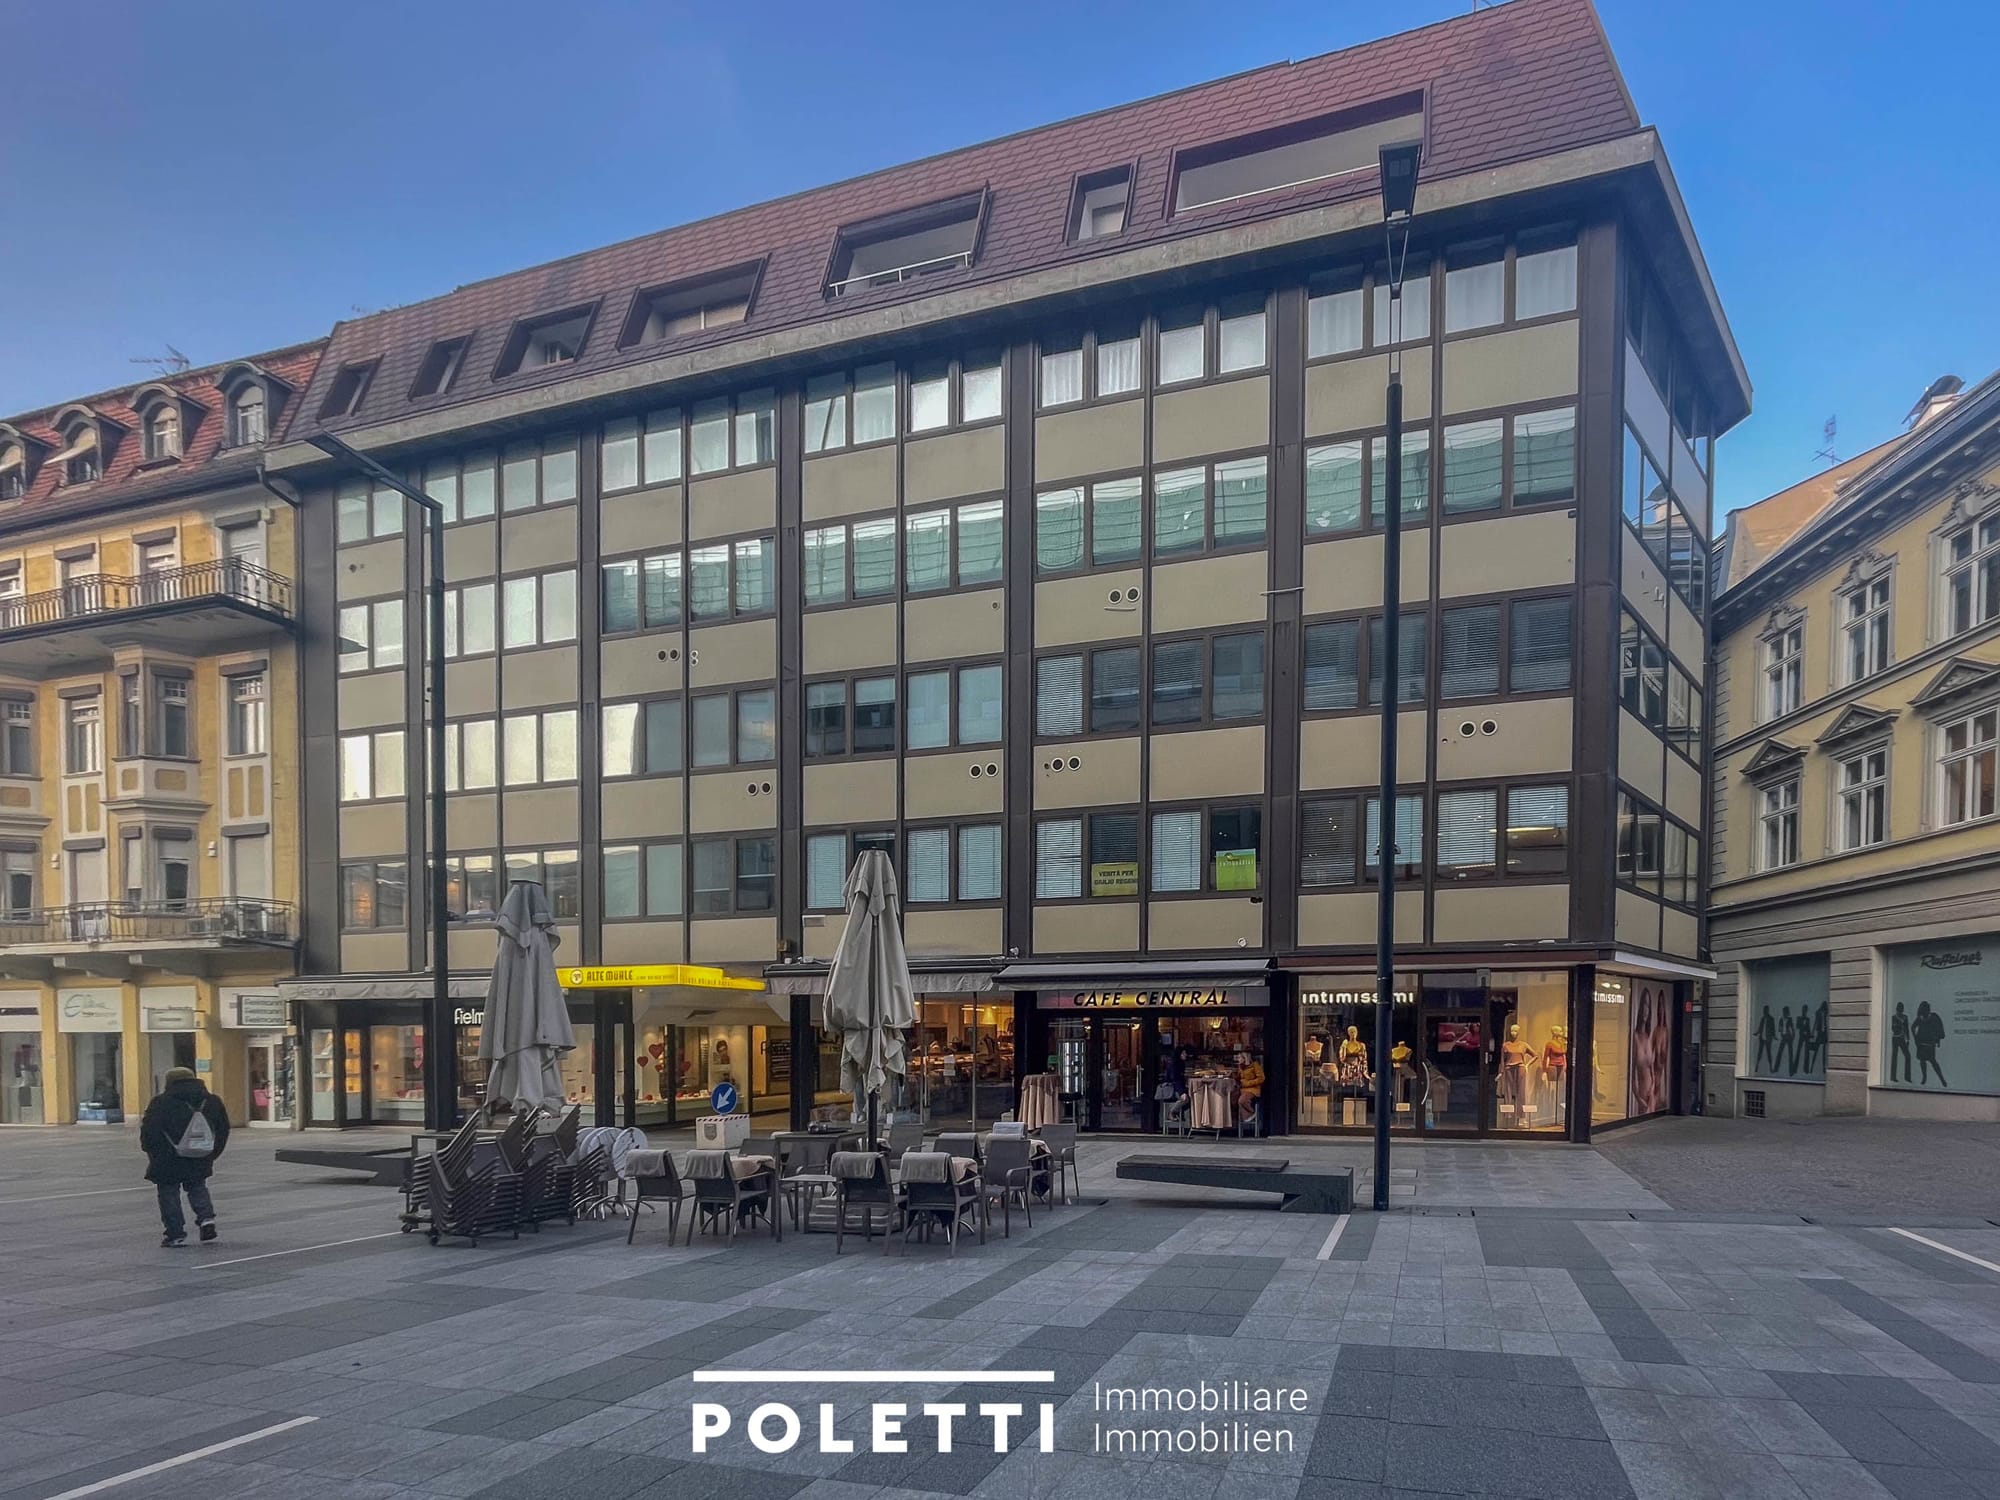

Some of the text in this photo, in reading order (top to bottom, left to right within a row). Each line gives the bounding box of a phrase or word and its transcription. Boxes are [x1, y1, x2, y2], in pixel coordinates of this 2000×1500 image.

[586, 970, 604, 982] ALTE
[1073, 988, 1229, 1006] CAFE CENTRAL
[1302, 991, 1414, 1004] intimissmi
[454, 1008, 485, 1025] fielm
